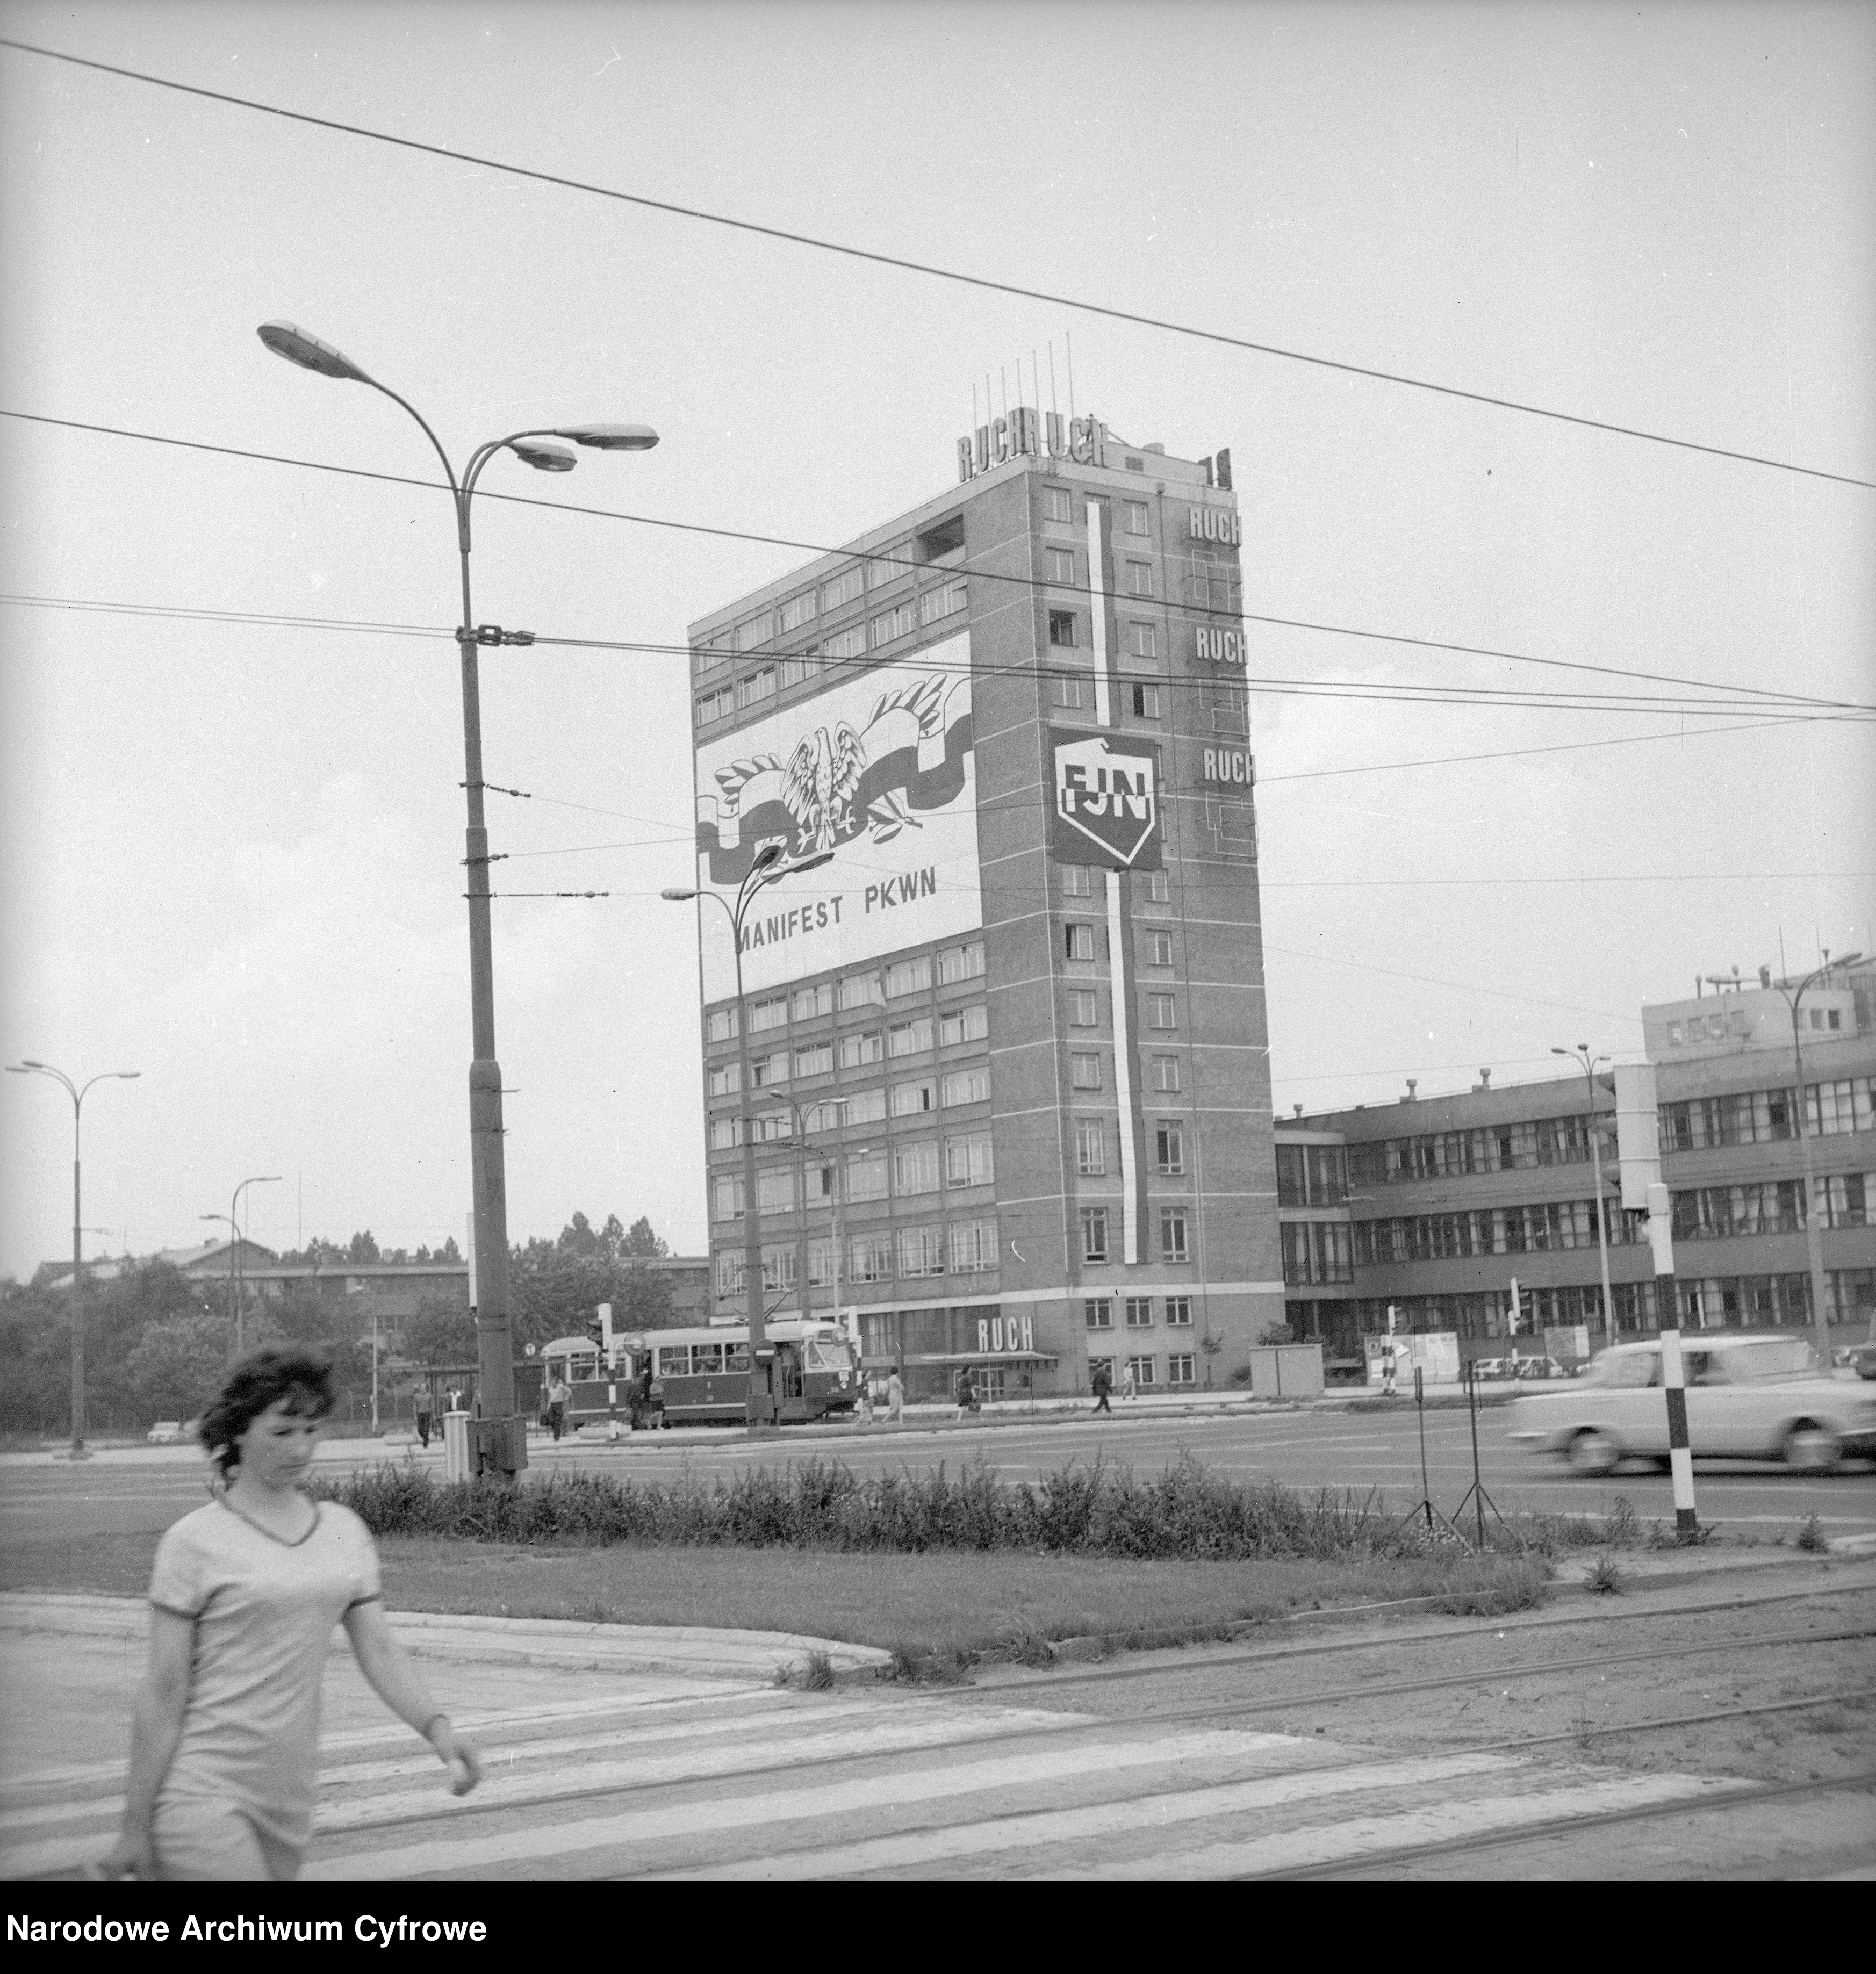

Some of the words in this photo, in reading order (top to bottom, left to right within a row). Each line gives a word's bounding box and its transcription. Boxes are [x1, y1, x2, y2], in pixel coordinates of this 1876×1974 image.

[957, 407, 1023, 483] RUCH
[1022, 407, 1108, 469] RUCH
[1189, 507, 1242, 546] RUCH
[1196, 627, 1249, 665] RUCH
[1204, 748, 1256, 785] RUCH
[1062, 763, 1147, 819] FJN
[738, 895, 843, 952] MANIFEST
[865, 866, 936, 913] PKWN
[978, 1316, 1034, 1352] RUCH
